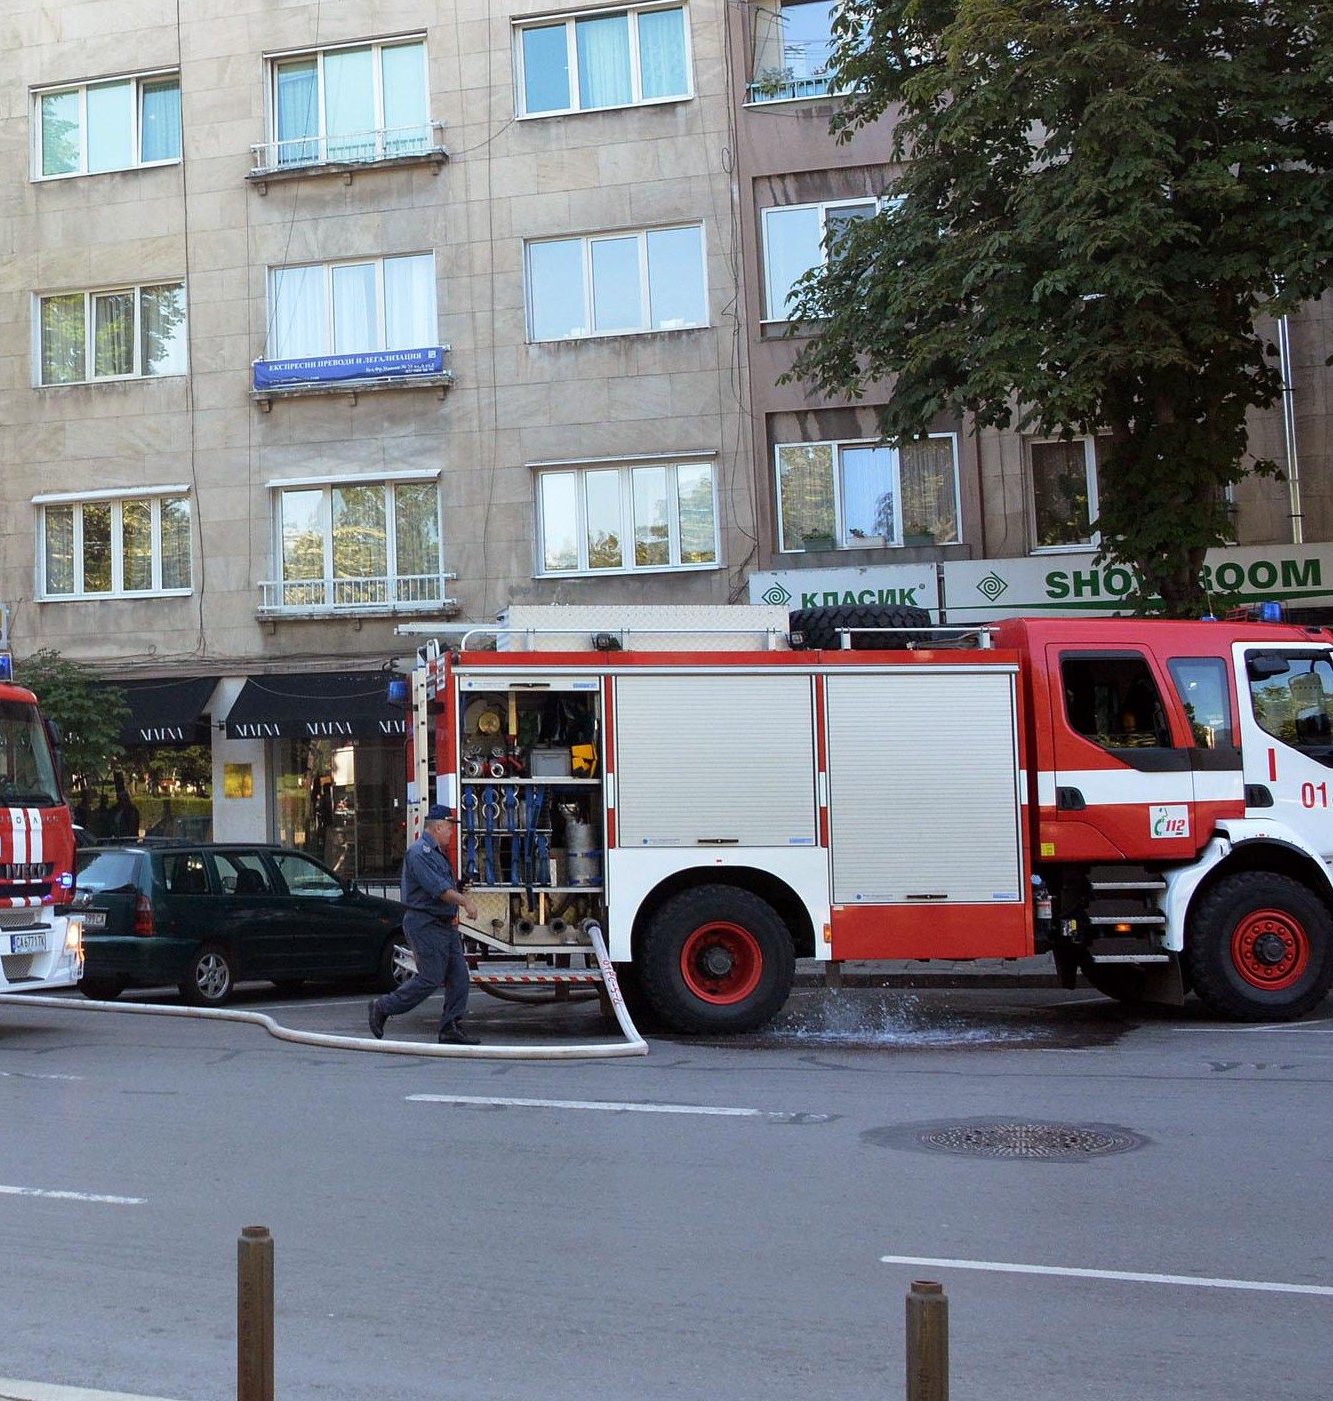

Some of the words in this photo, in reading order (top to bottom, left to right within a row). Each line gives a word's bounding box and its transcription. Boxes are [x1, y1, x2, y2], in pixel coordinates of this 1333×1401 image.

[269, 361, 316, 371] ЕКСПРЕСНИ
[318, 358, 355, 367] ПРЕВОДИ
[801, 587, 918, 609] КЛАСИК
[1301, 782, 1328, 809] 01
[1165, 819, 1186, 832] 112
[6, 863, 47, 880] IVECO
